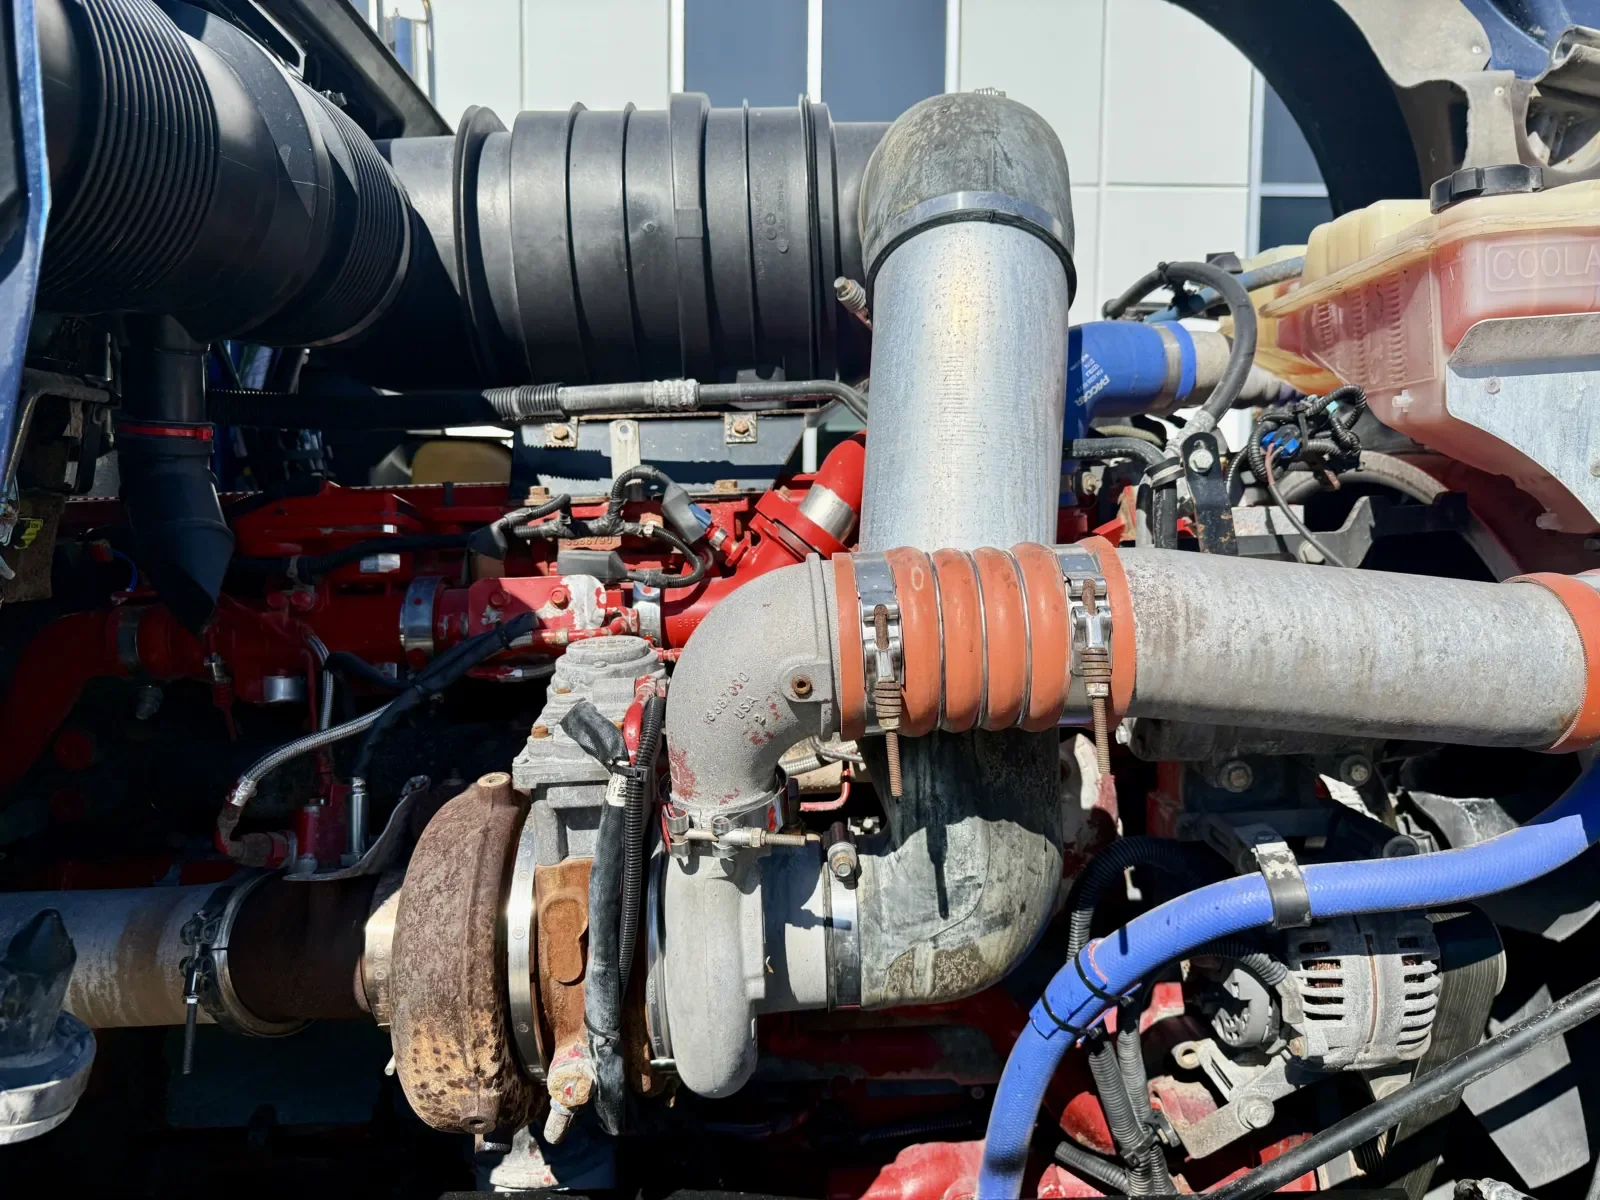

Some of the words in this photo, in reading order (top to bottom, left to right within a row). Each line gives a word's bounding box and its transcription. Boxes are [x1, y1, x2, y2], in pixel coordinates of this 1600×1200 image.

[1493, 244, 1600, 281] COOLA
[1074, 374, 1110, 407] PACCAR
[733, 695, 760, 720] USA
